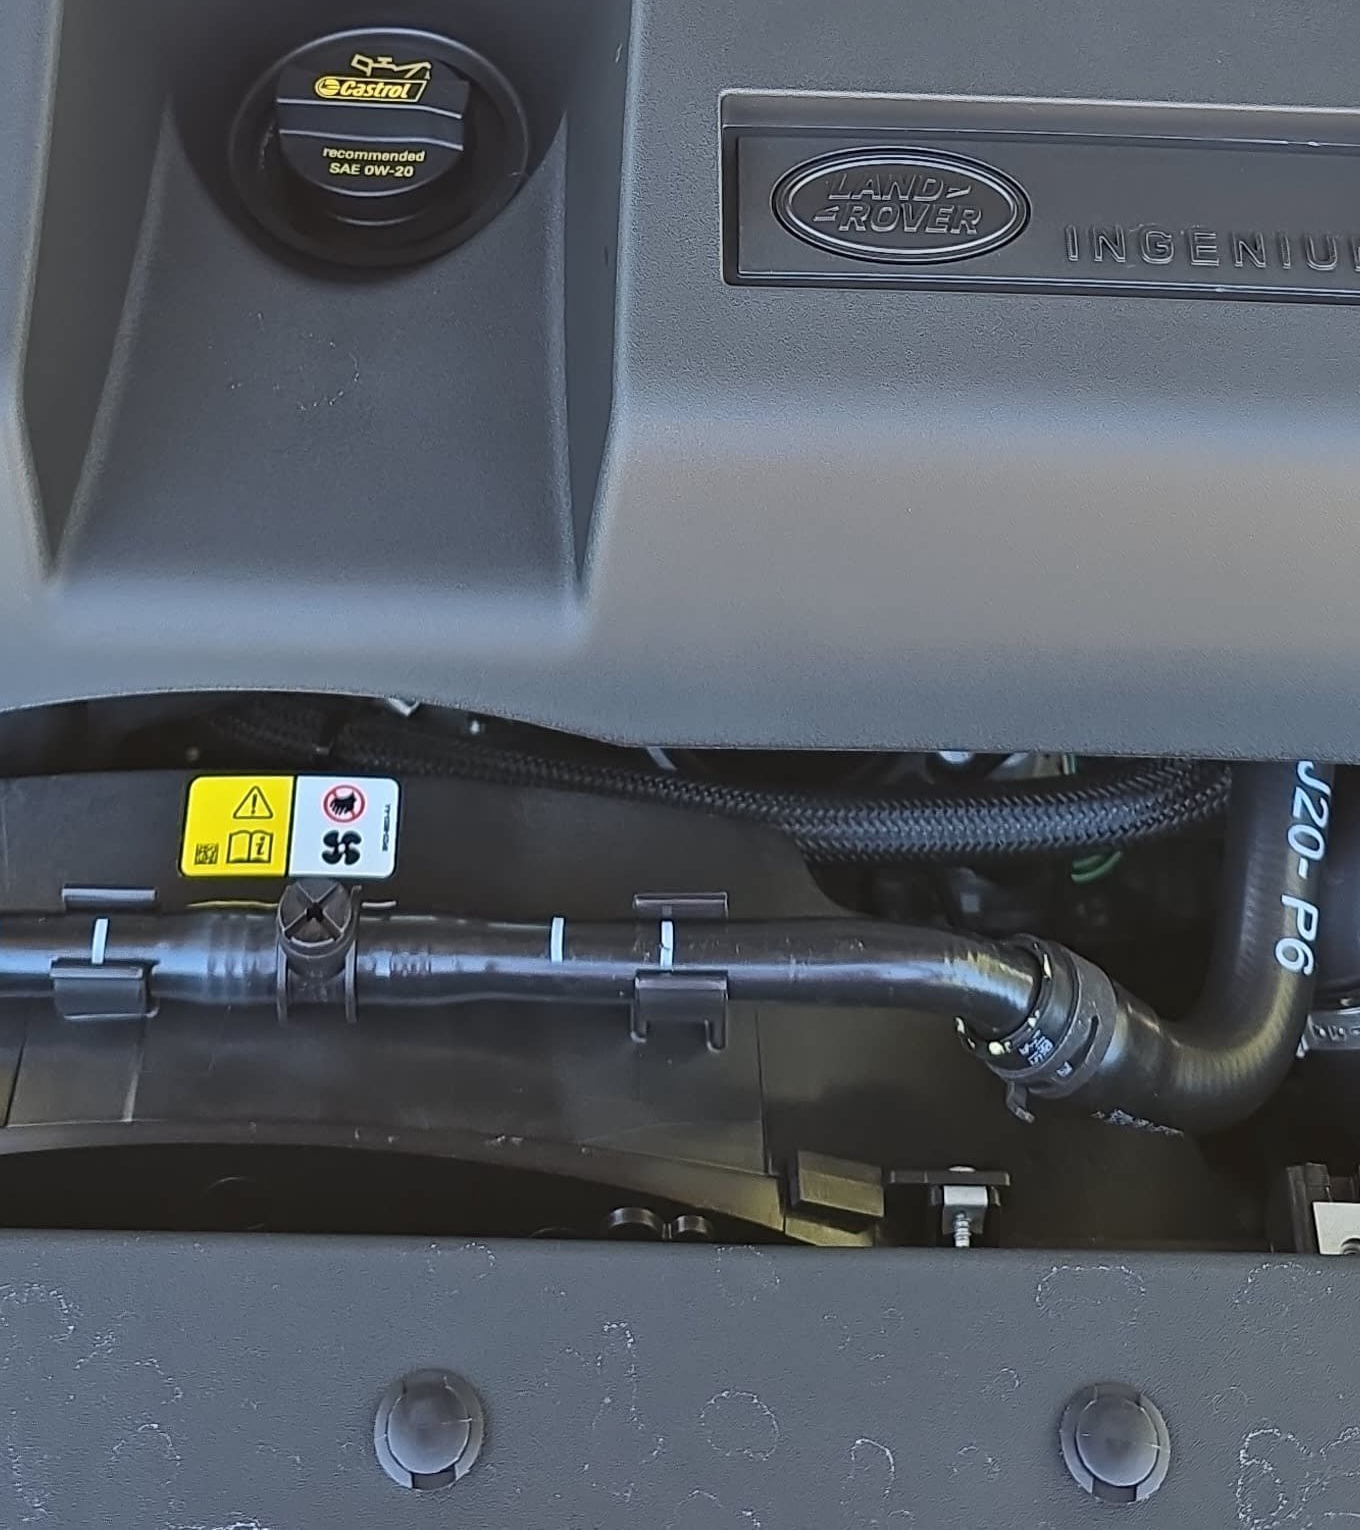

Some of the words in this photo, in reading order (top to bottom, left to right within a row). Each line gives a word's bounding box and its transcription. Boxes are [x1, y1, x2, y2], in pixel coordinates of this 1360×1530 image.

[339, 80, 411, 99] Castrol
[322, 146, 426, 162] recommended
[329, 162, 361, 175] SAE
[364, 164, 414, 177] 0W-20
[827, 173, 944, 201] LAND
[837, 201, 983, 234] ROVER
